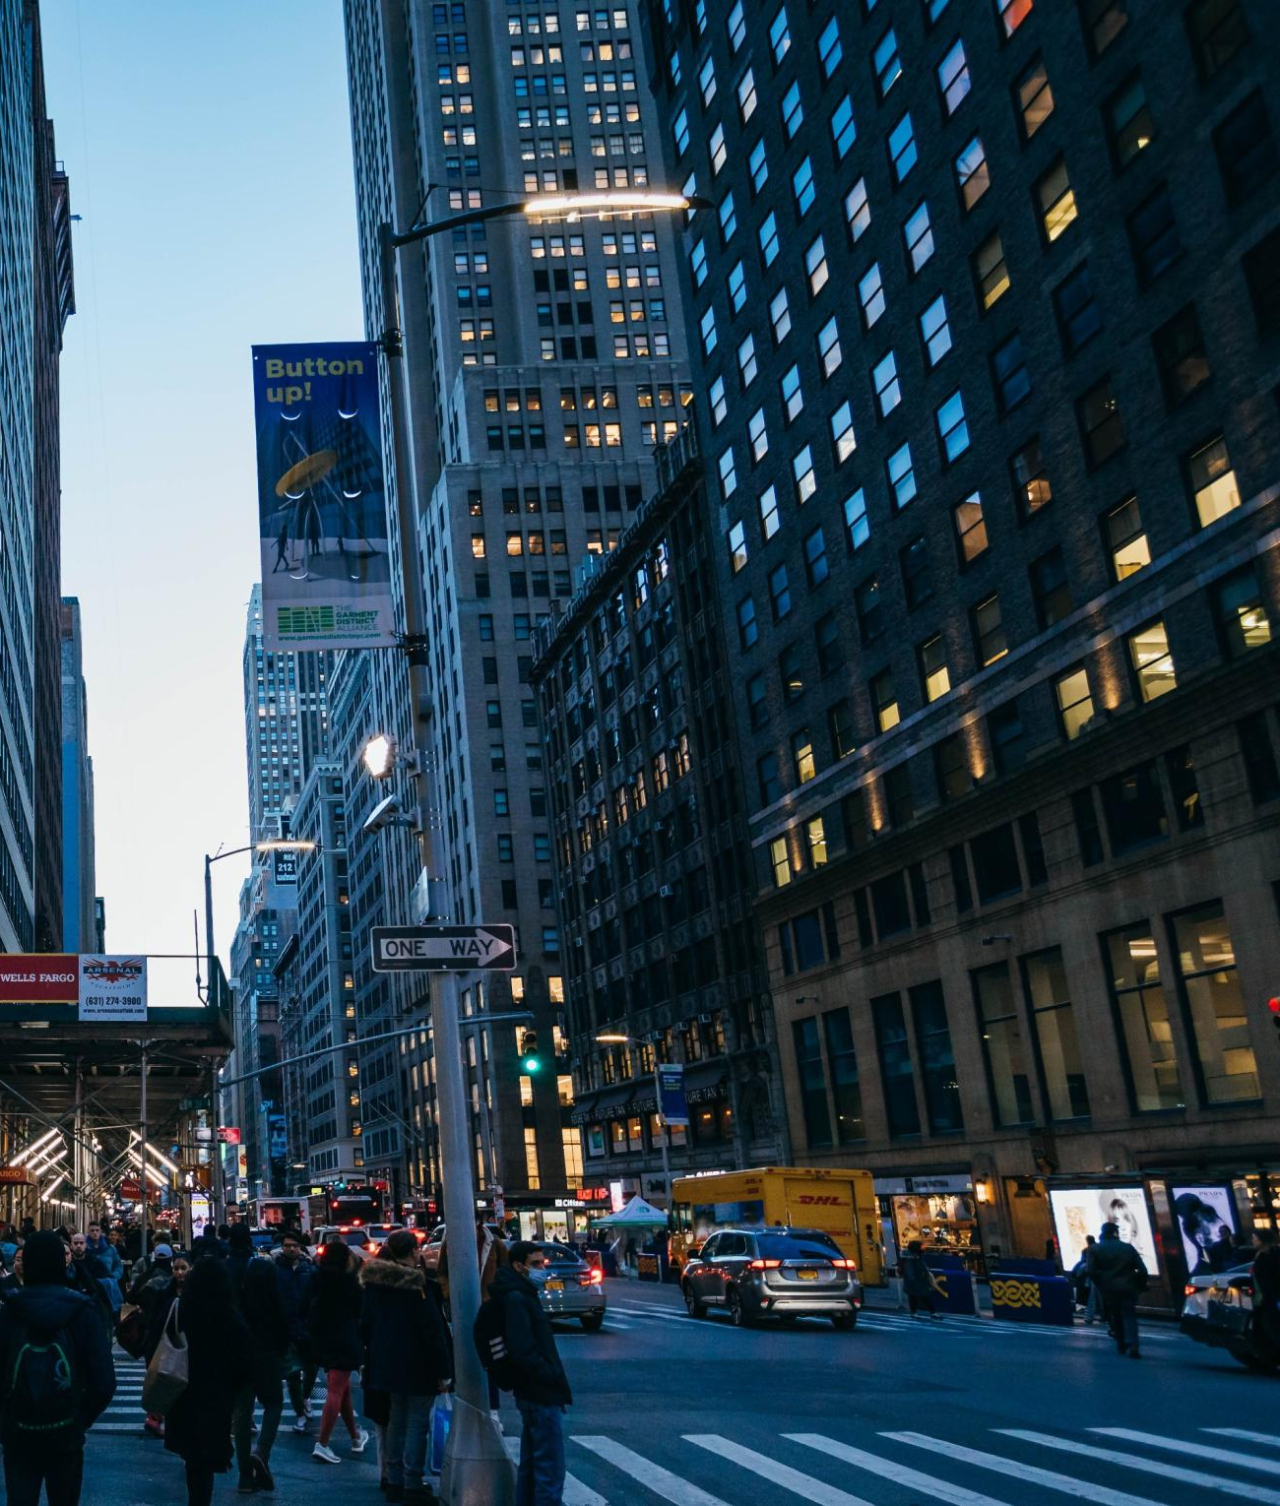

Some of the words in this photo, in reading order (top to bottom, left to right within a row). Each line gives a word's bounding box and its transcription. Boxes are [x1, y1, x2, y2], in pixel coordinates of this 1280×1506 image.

[265, 358, 363, 379] Button
[267, 382, 312, 405] up!
[336, 610, 379, 618] GARMENT
[336, 617, 376, 625] DISTRICT
[337, 624, 379, 632] ALLIANCE
[278, 633, 382, 641] www.garmentdistrictnyc.com
[277, 862, 293, 872] 212
[385, 940, 426, 957] ONE
[449, 938, 494, 956] WAY
[0, 973, 36, 982] WELLS
[39, 973, 75, 982] FARGO
[85, 996, 105, 1007] (631)
[105, 996, 142, 1006] 274-3900
[703, 1086, 717, 1100] TAN
[799, 1196, 841, 1206] DHL
